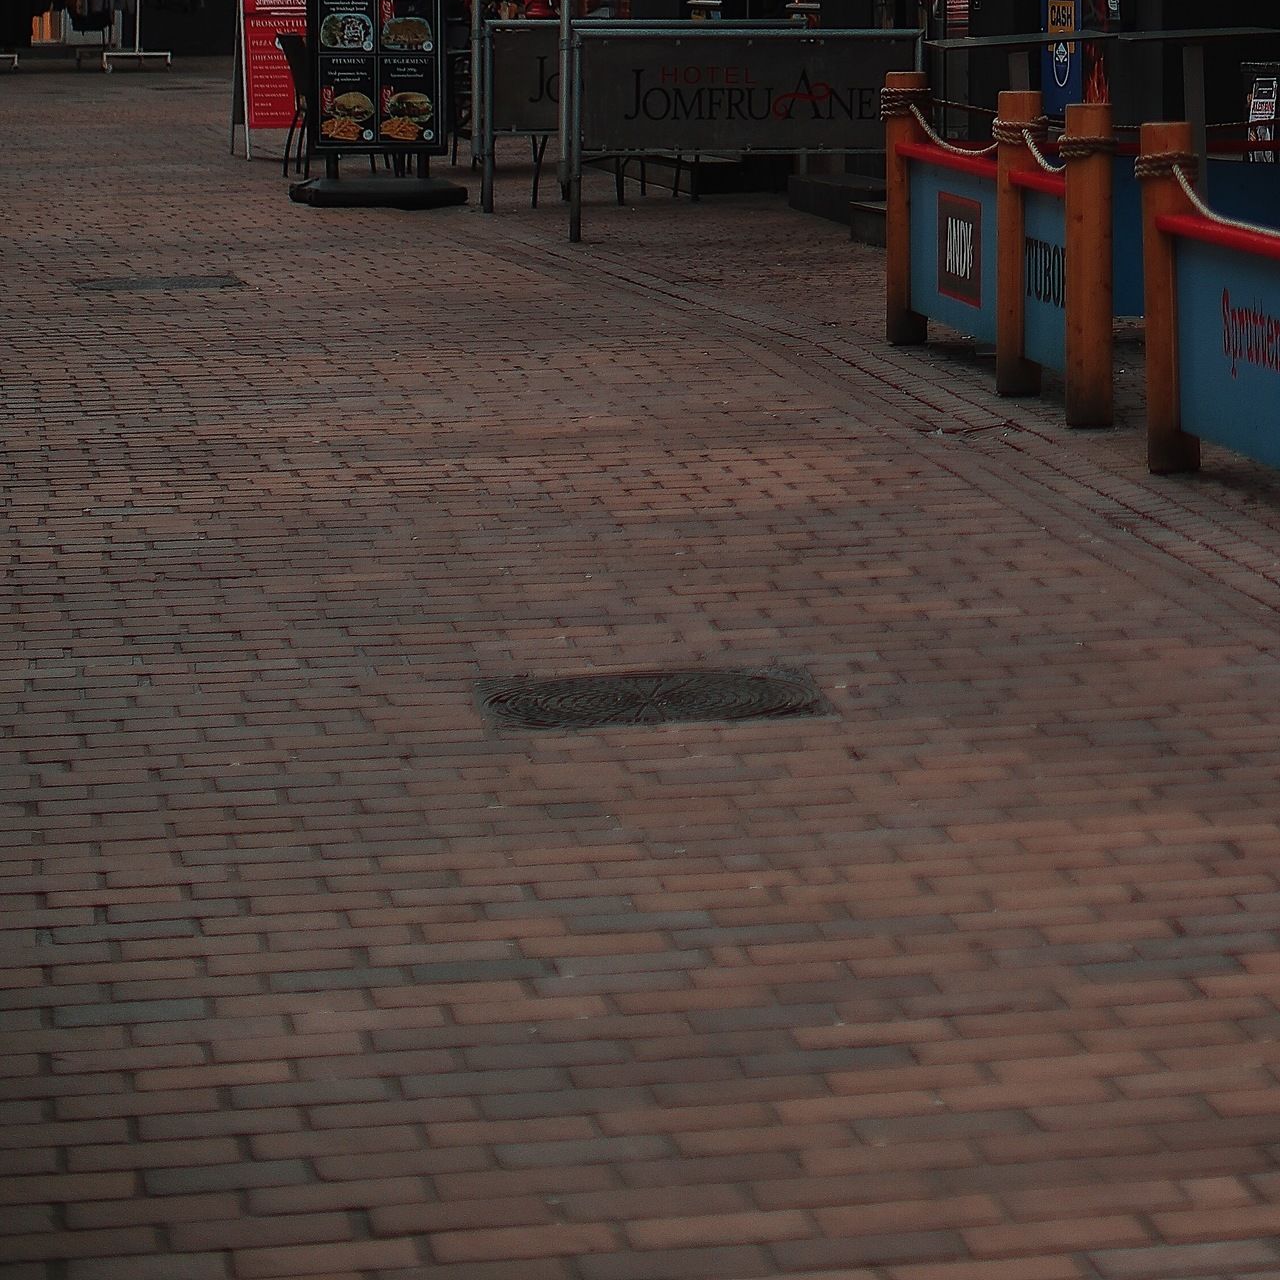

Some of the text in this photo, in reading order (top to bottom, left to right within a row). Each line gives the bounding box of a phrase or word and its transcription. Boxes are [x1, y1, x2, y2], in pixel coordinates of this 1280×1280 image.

[1050, 4, 1073, 27] CASH
[661, 66, 758, 85] HOTEL
[624, 68, 876, 121] JOMFRU ANE
